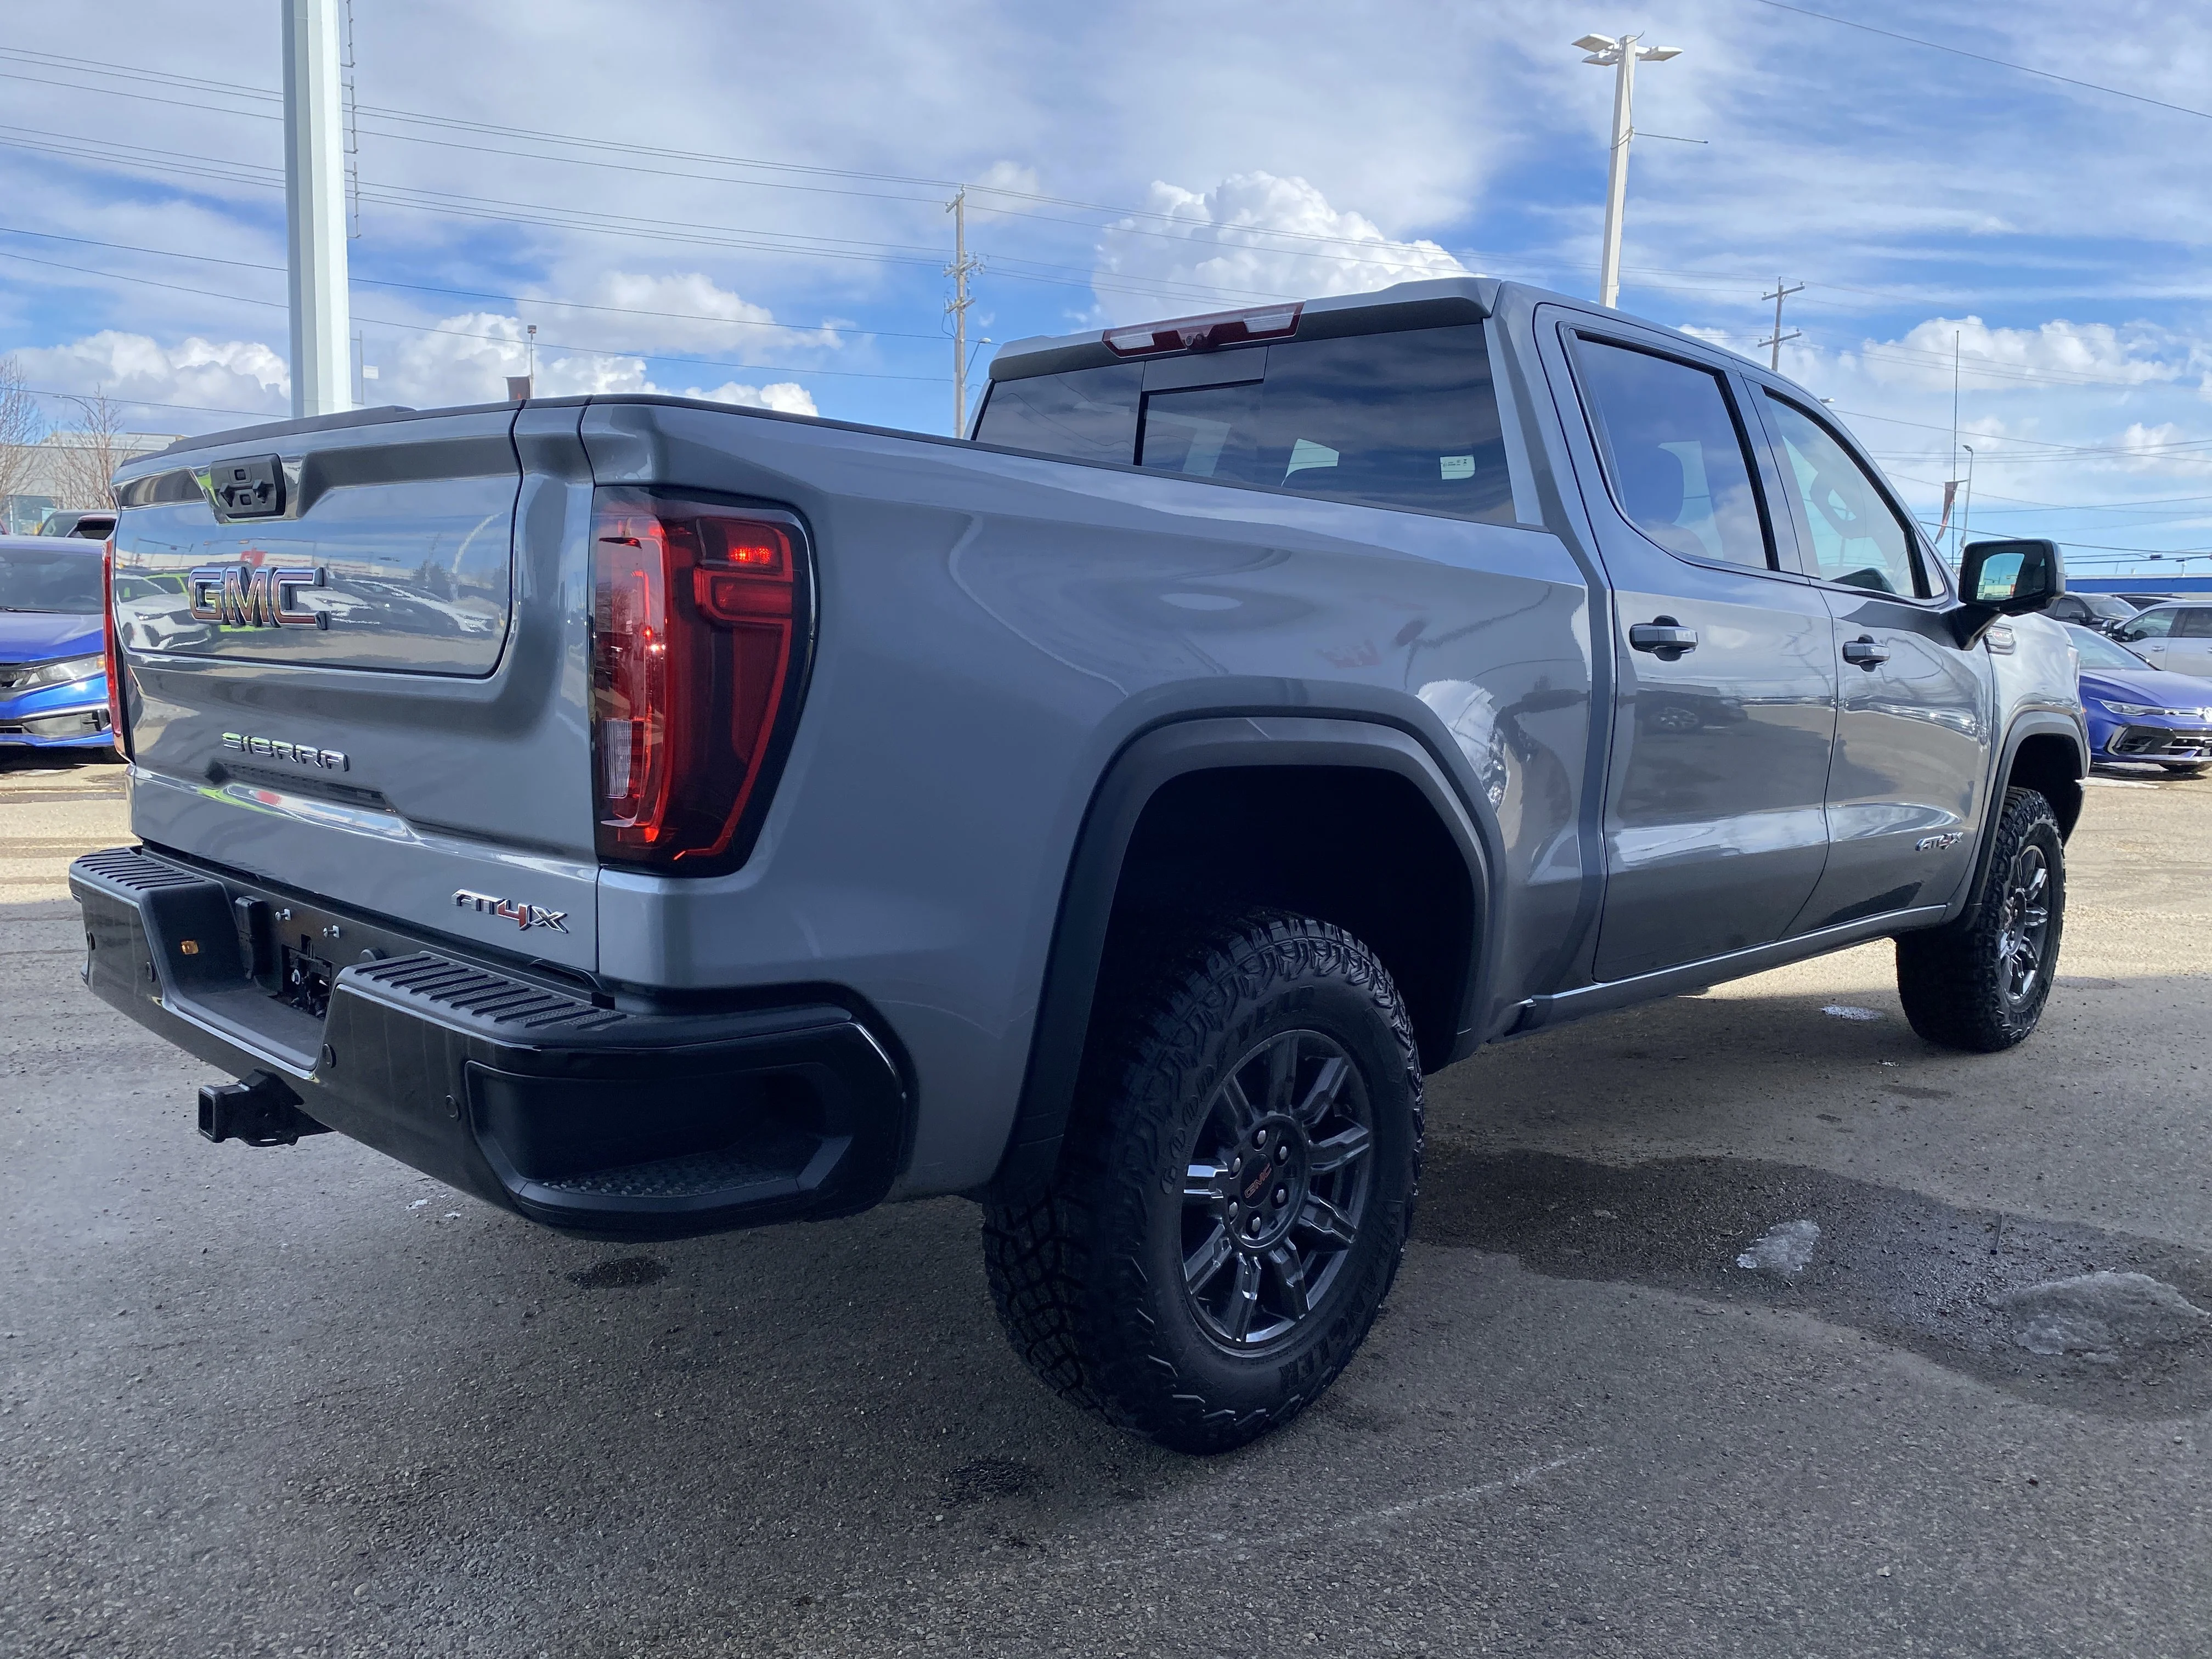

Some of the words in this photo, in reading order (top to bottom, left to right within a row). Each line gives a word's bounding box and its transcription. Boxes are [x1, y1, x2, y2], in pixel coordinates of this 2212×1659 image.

[188, 566, 329, 630] GMC
[222, 731, 351, 772] SIERRA
[1915, 831, 1964, 851] AT4X
[451, 888, 569, 933] AT4X
[1244, 1163, 1272, 1198] GMC
